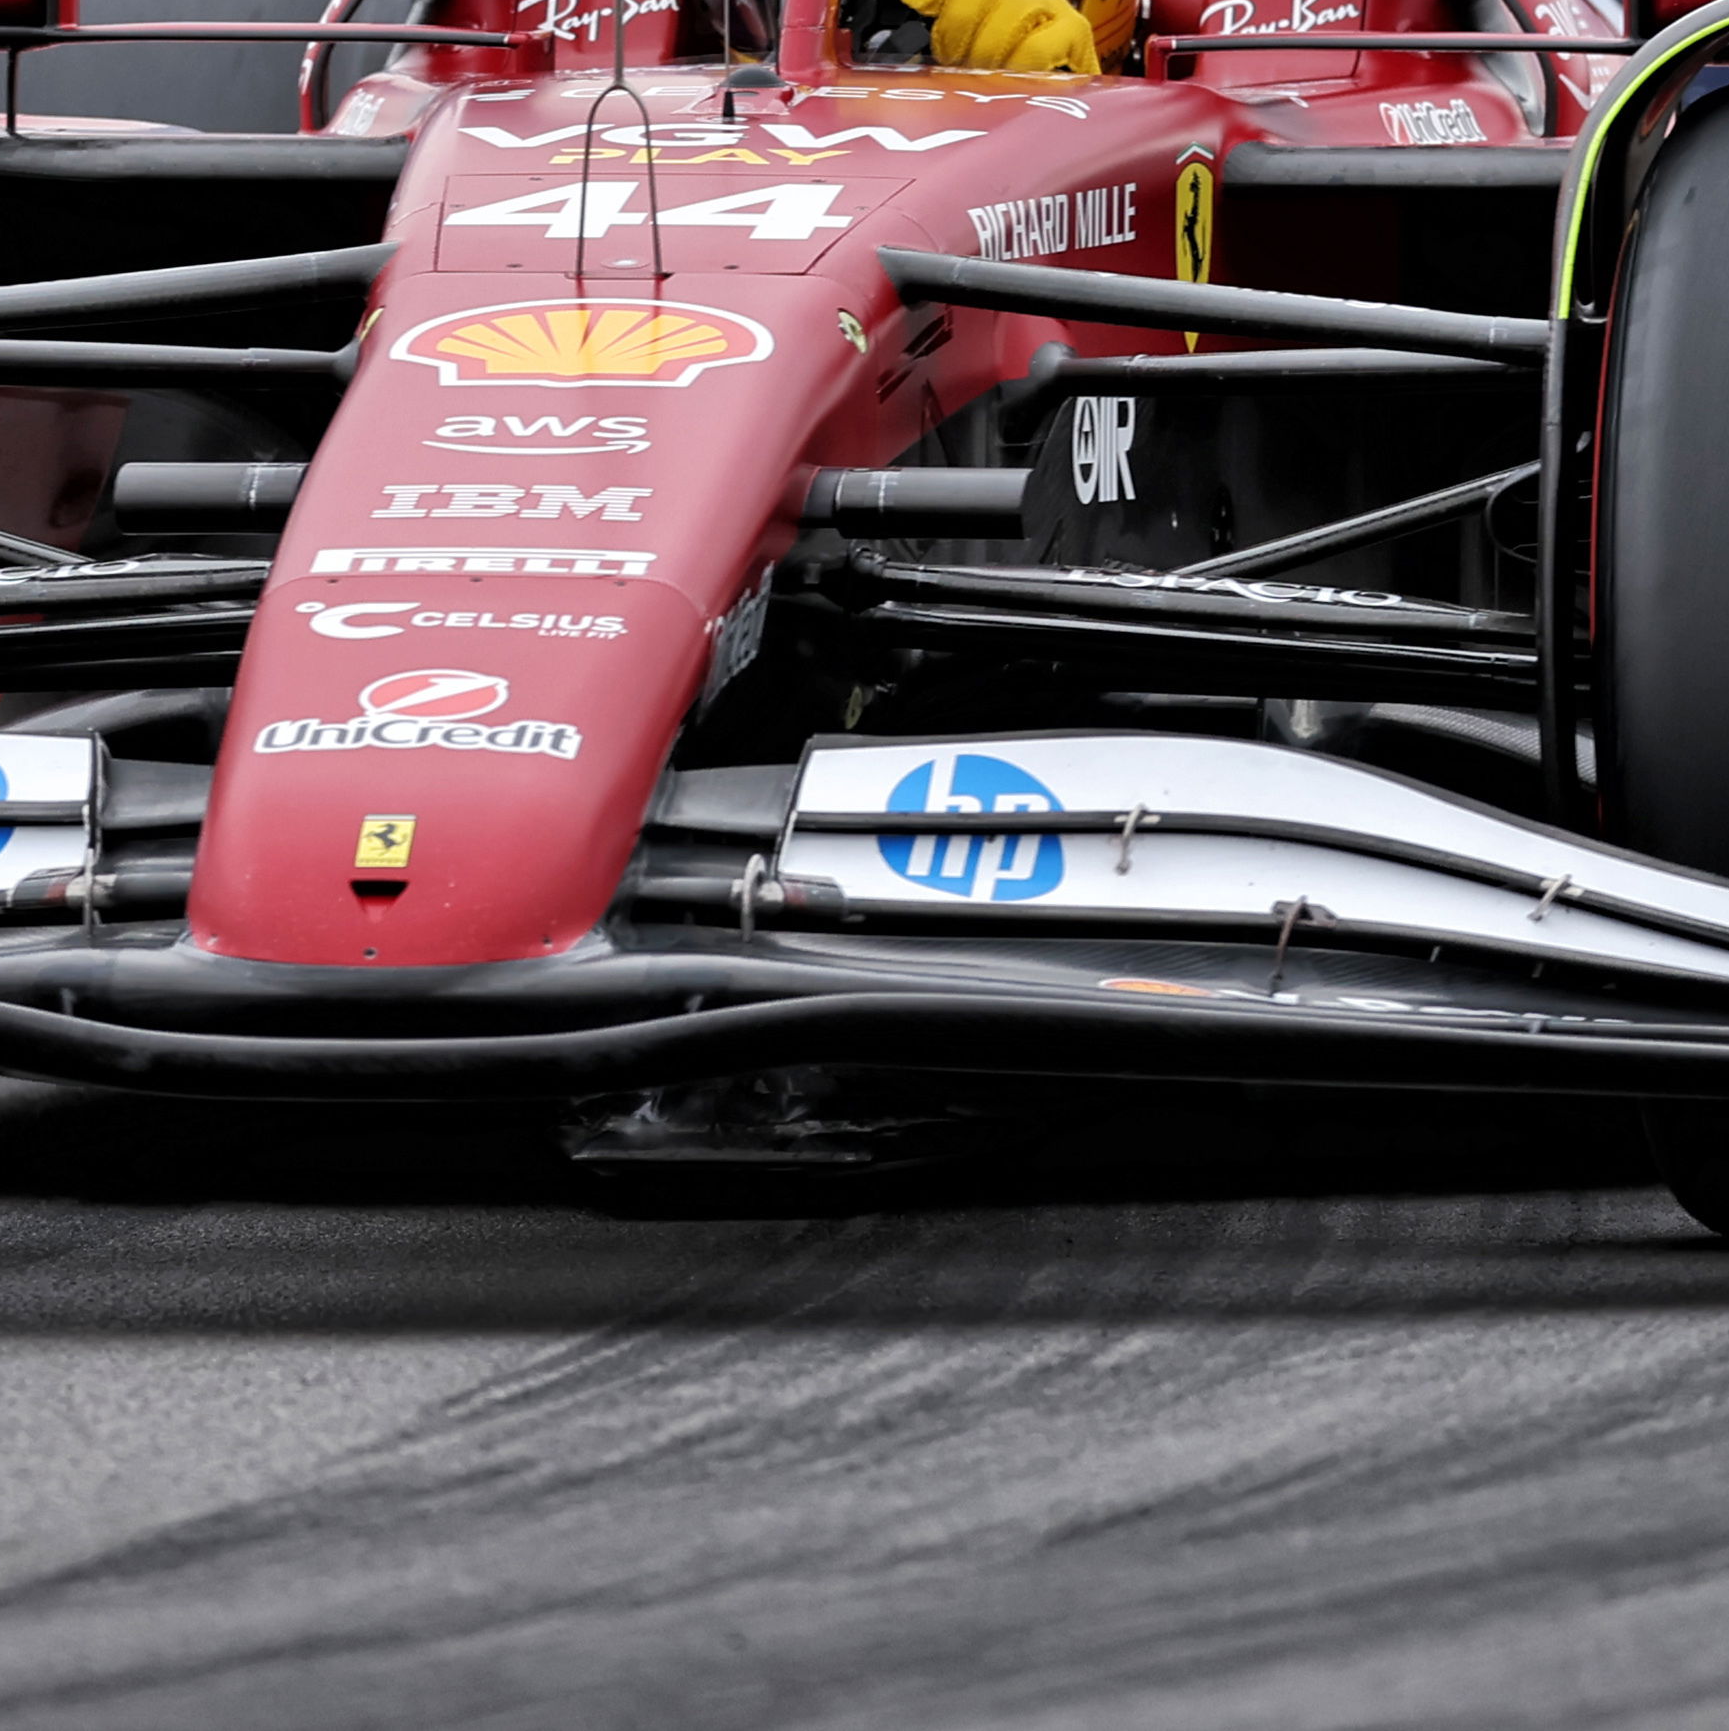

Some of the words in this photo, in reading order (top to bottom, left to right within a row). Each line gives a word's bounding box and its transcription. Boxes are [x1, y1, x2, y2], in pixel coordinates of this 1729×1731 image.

[559, 85, 1092, 119] GEESYS
[458, 122, 989, 152] VGW
[548, 147, 853, 166] PLAY
[443, 180, 854, 240] 44
[966, 194, 1069, 262] RICHARD
[1075, 182, 1137, 250] MILLE
[433, 415, 651, 444] aws
[370, 485, 654, 522] IBM
[309, 547, 658, 576] PIRELLI
[410, 611, 626, 632] CELSIUS
[537, 628, 581, 638] LIVE
[254, 717, 583, 761] UniCredit
[898, 754, 1056, 901] hp
